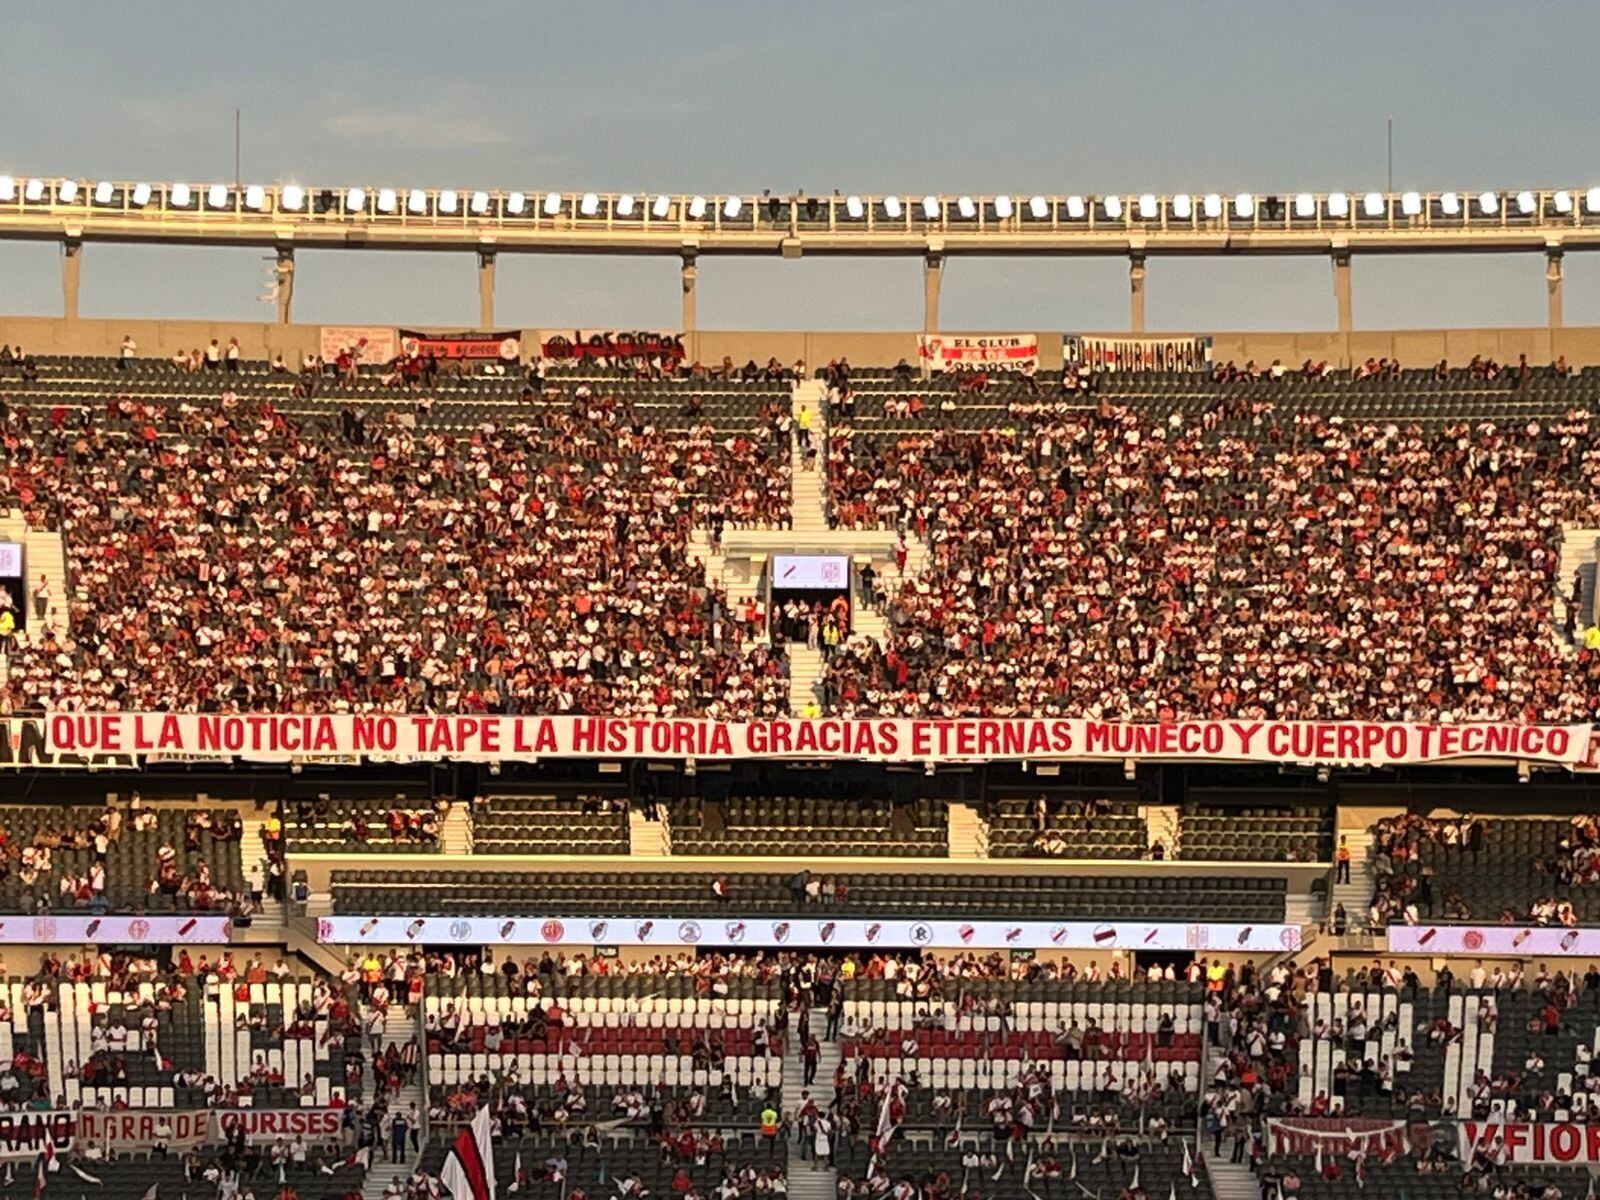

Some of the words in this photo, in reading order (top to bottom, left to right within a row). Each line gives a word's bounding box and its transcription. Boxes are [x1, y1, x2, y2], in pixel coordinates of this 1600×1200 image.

[52, 715, 121, 750] QUE
[134, 715, 183, 749] LA
[199, 717, 337, 751] NOTICIA
[352, 718, 397, 750] NO
[411, 719, 500, 752] TAPE
[513, 719, 558, 752] LA
[573, 718, 732, 754] HISTORIA
[747, 721, 899, 754] GRACIAS
[912, 721, 1071, 755] ETERNAS
[1086, 721, 1223, 753] MUNECO
[1231, 723, 1263, 753] Y
[1268, 724, 1407, 758] CUERPO
[1416, 726, 1569, 758] TECNICO
